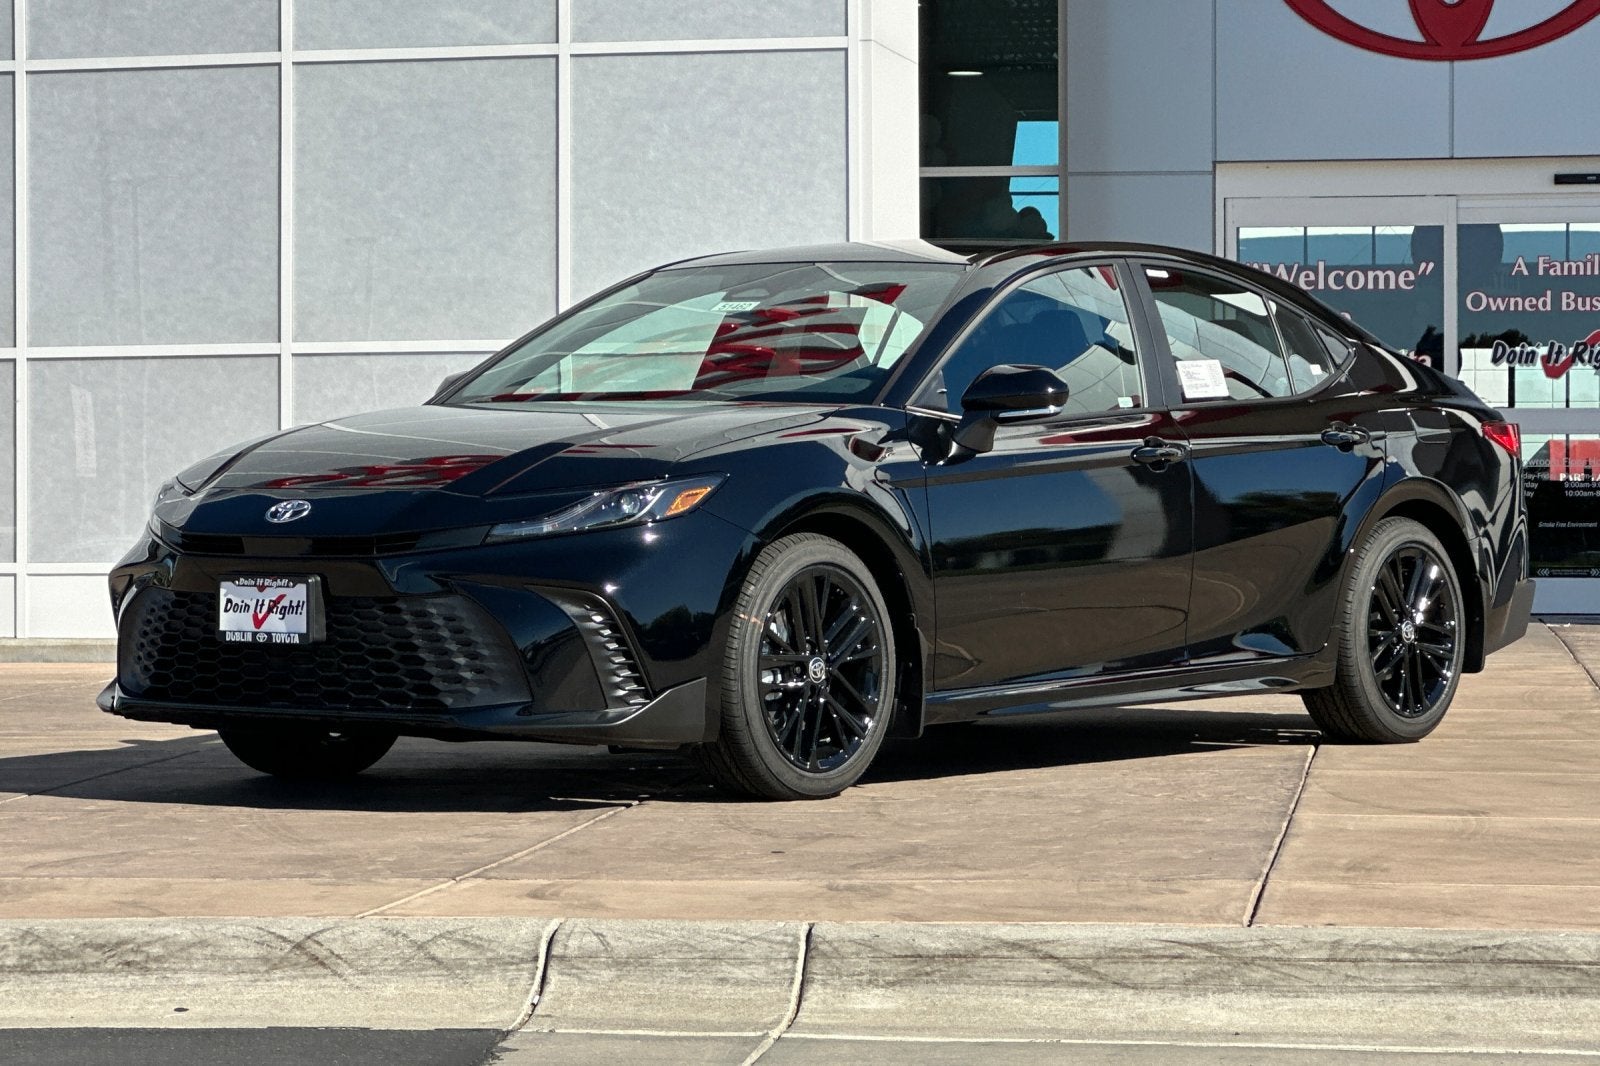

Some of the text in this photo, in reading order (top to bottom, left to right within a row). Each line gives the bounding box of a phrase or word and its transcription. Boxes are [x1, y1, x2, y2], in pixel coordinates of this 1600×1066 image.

[1511, 254, 1600, 276] A Famil
[1465, 290, 1552, 312] Owned
[1546, 340, 1566, 366] It
[254, 598, 266, 614] It
[267, 600, 306, 620] Right!
[225, 631, 300, 644] DUBLIN TOYOTA
